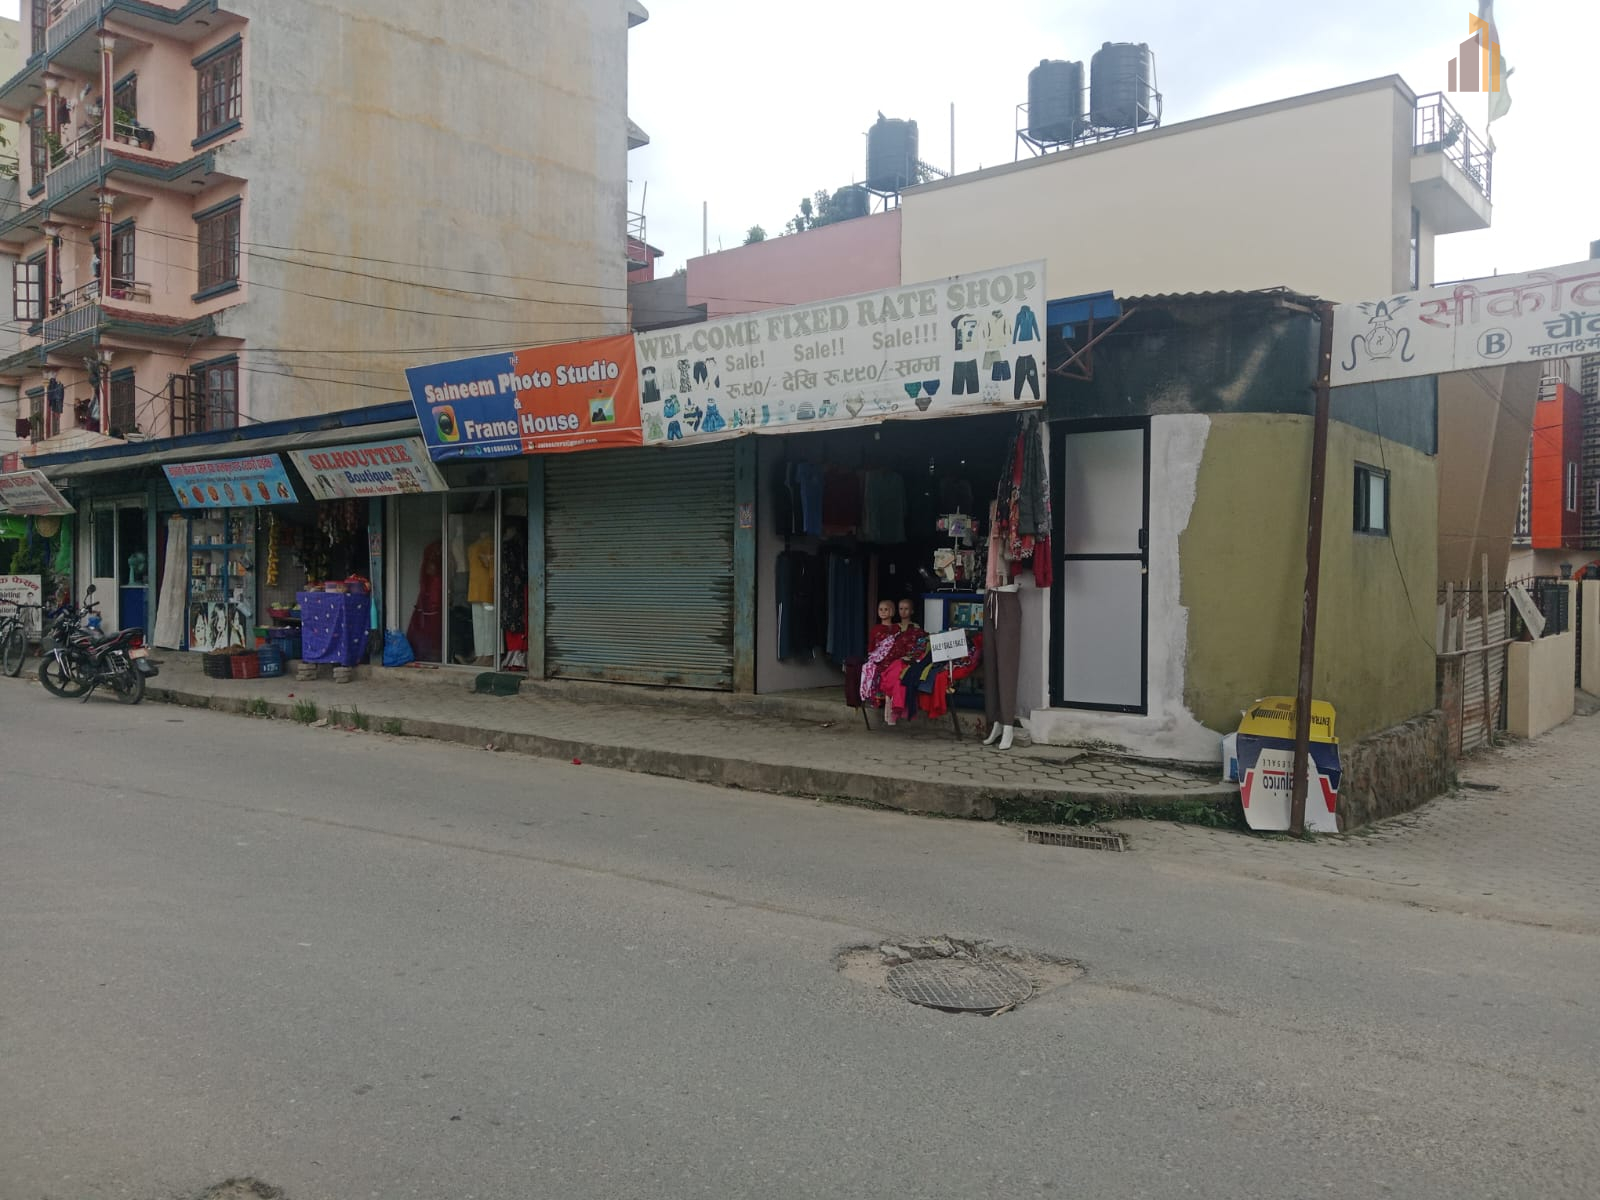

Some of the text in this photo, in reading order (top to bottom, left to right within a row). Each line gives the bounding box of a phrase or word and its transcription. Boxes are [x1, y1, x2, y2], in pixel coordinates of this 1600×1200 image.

[766, 304, 849, 341] FIXED
[856, 288, 938, 327] RATE
[946, 270, 1037, 312] SHOP
[725, 322, 938, 373] Sale! Sale!! Sale!!!
[1485, 332, 1506, 355] B
[509, 354, 520, 366] THE
[424, 359, 620, 404] Saineem Photo Studio
[513, 398, 523, 410] &
[464, 411, 580, 441] Frame House
[309, 444, 412, 471] SILHOUTTEE
[344, 468, 395, 485] Boutique
